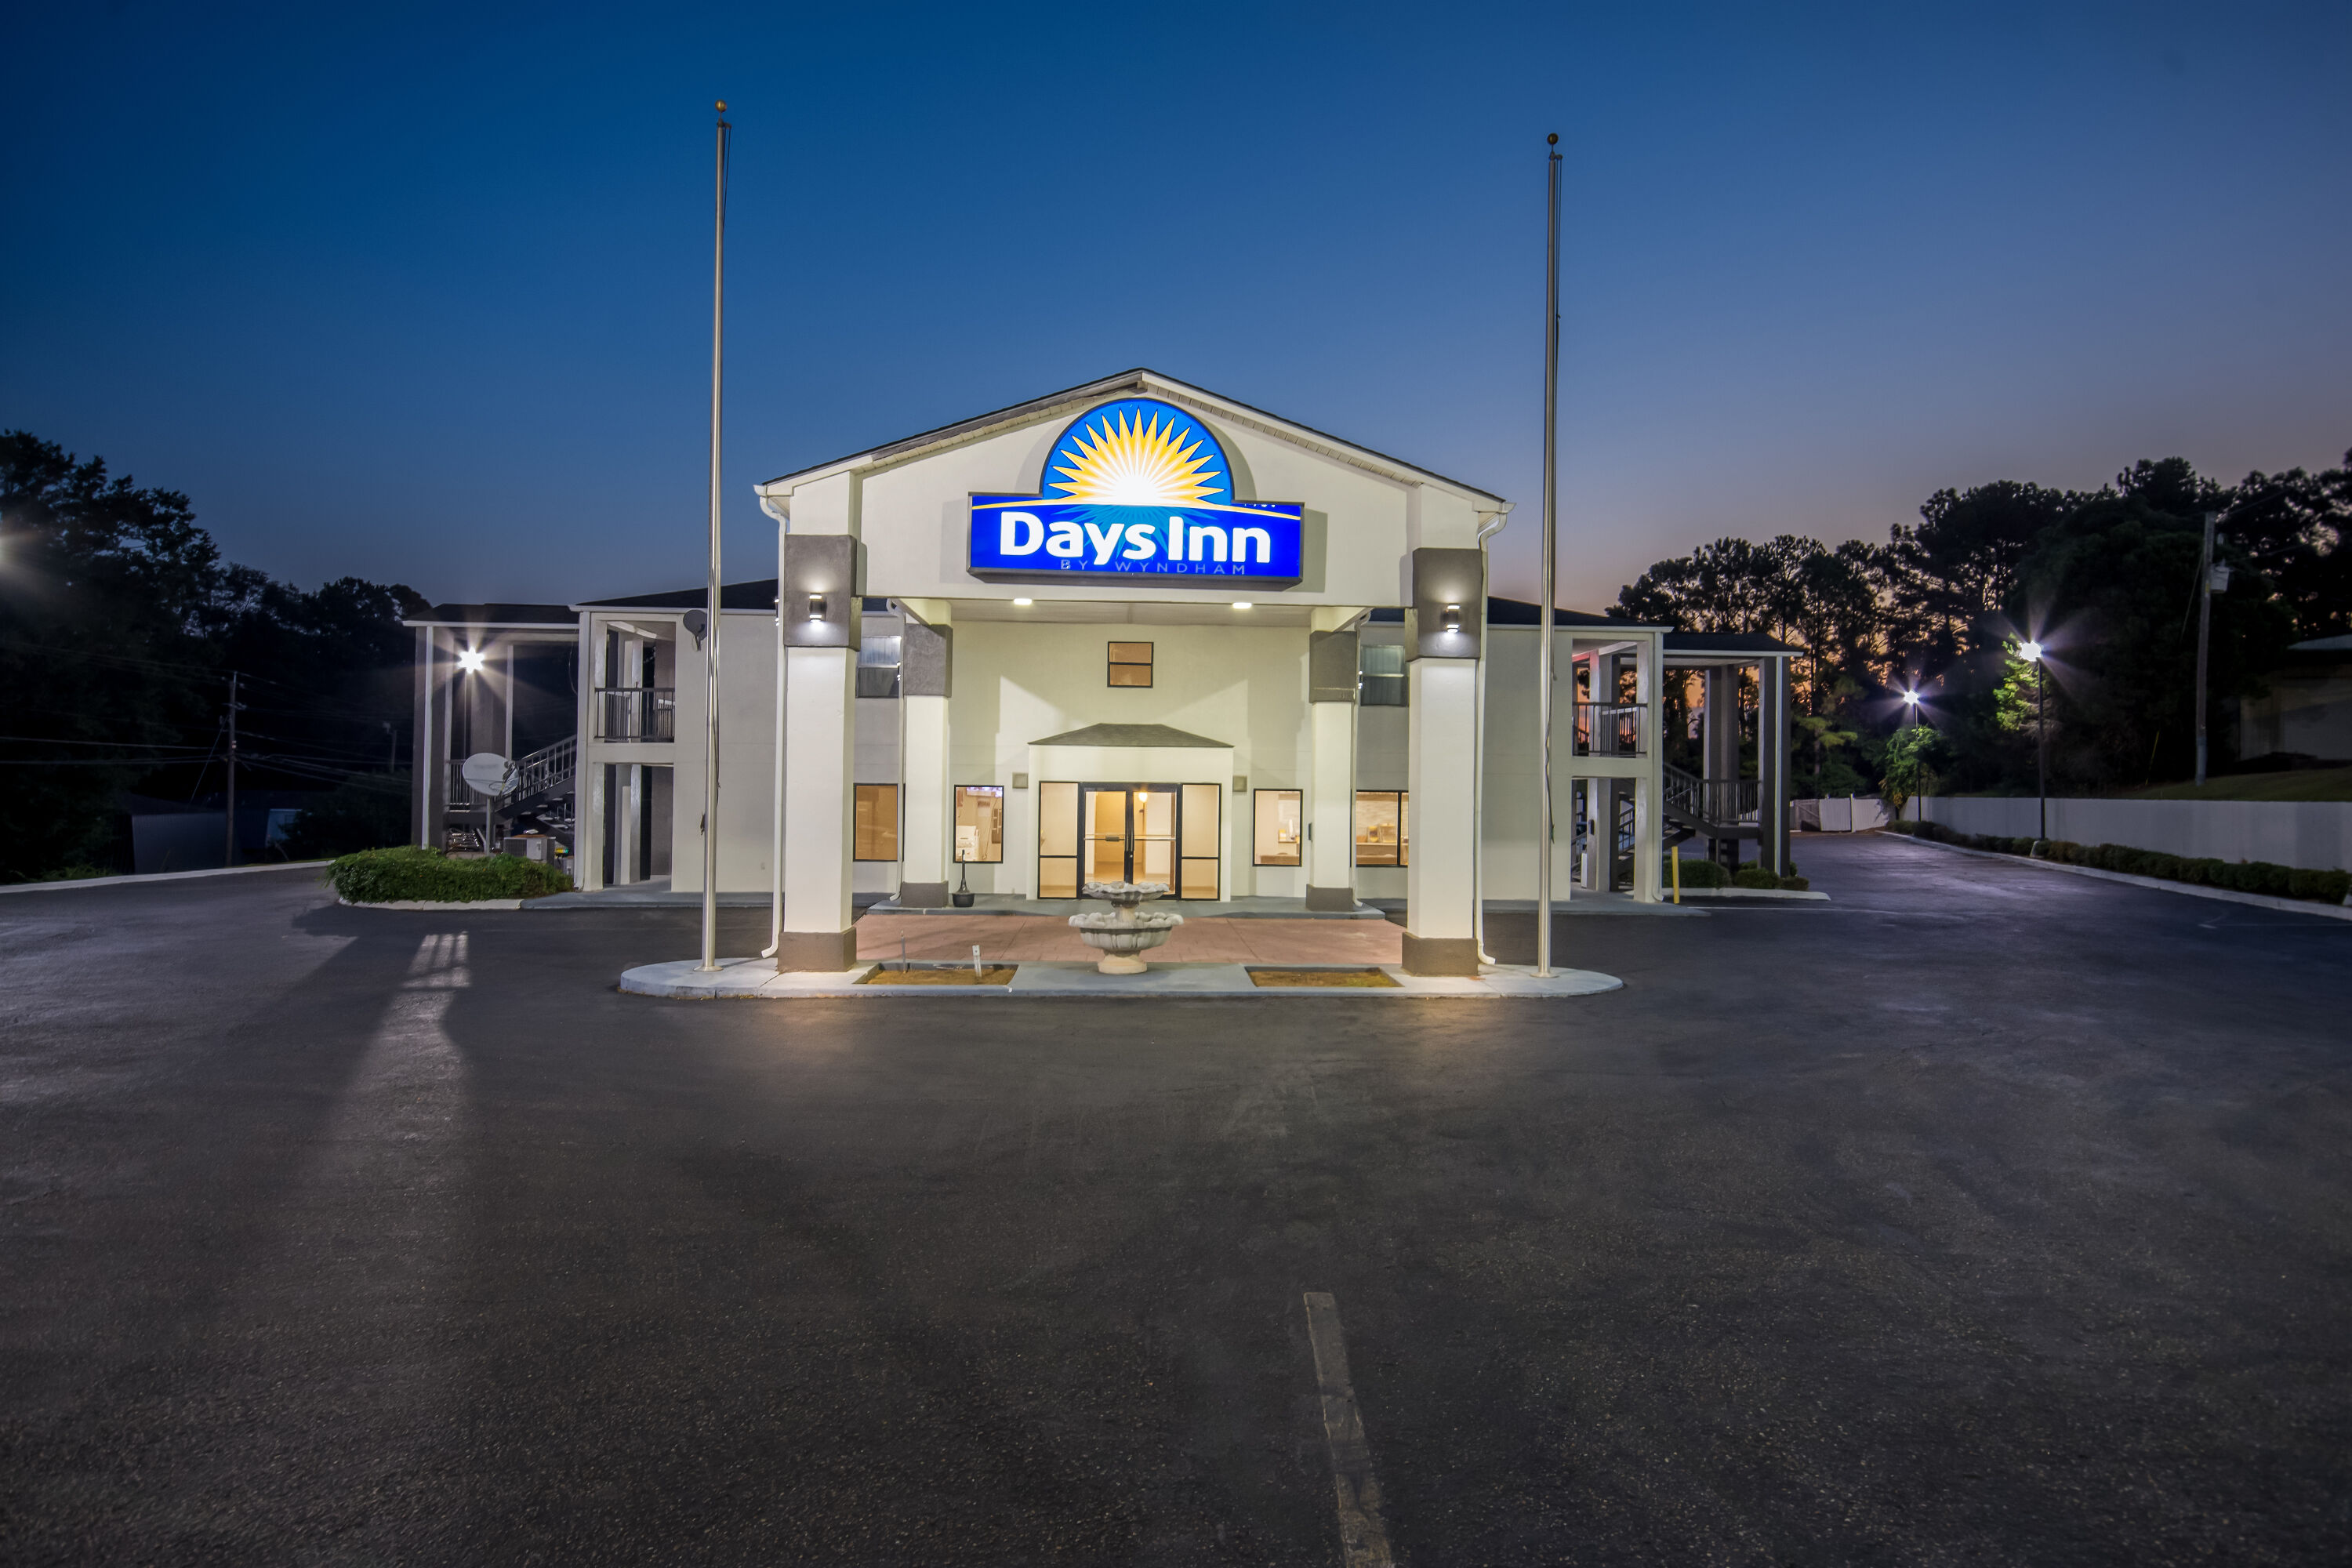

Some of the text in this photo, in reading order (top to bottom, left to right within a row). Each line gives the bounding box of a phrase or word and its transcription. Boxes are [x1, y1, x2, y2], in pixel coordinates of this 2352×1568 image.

[1000, 511, 1271, 565] Days Inn
[1061, 559, 1245, 575] BY WYNDHAM
